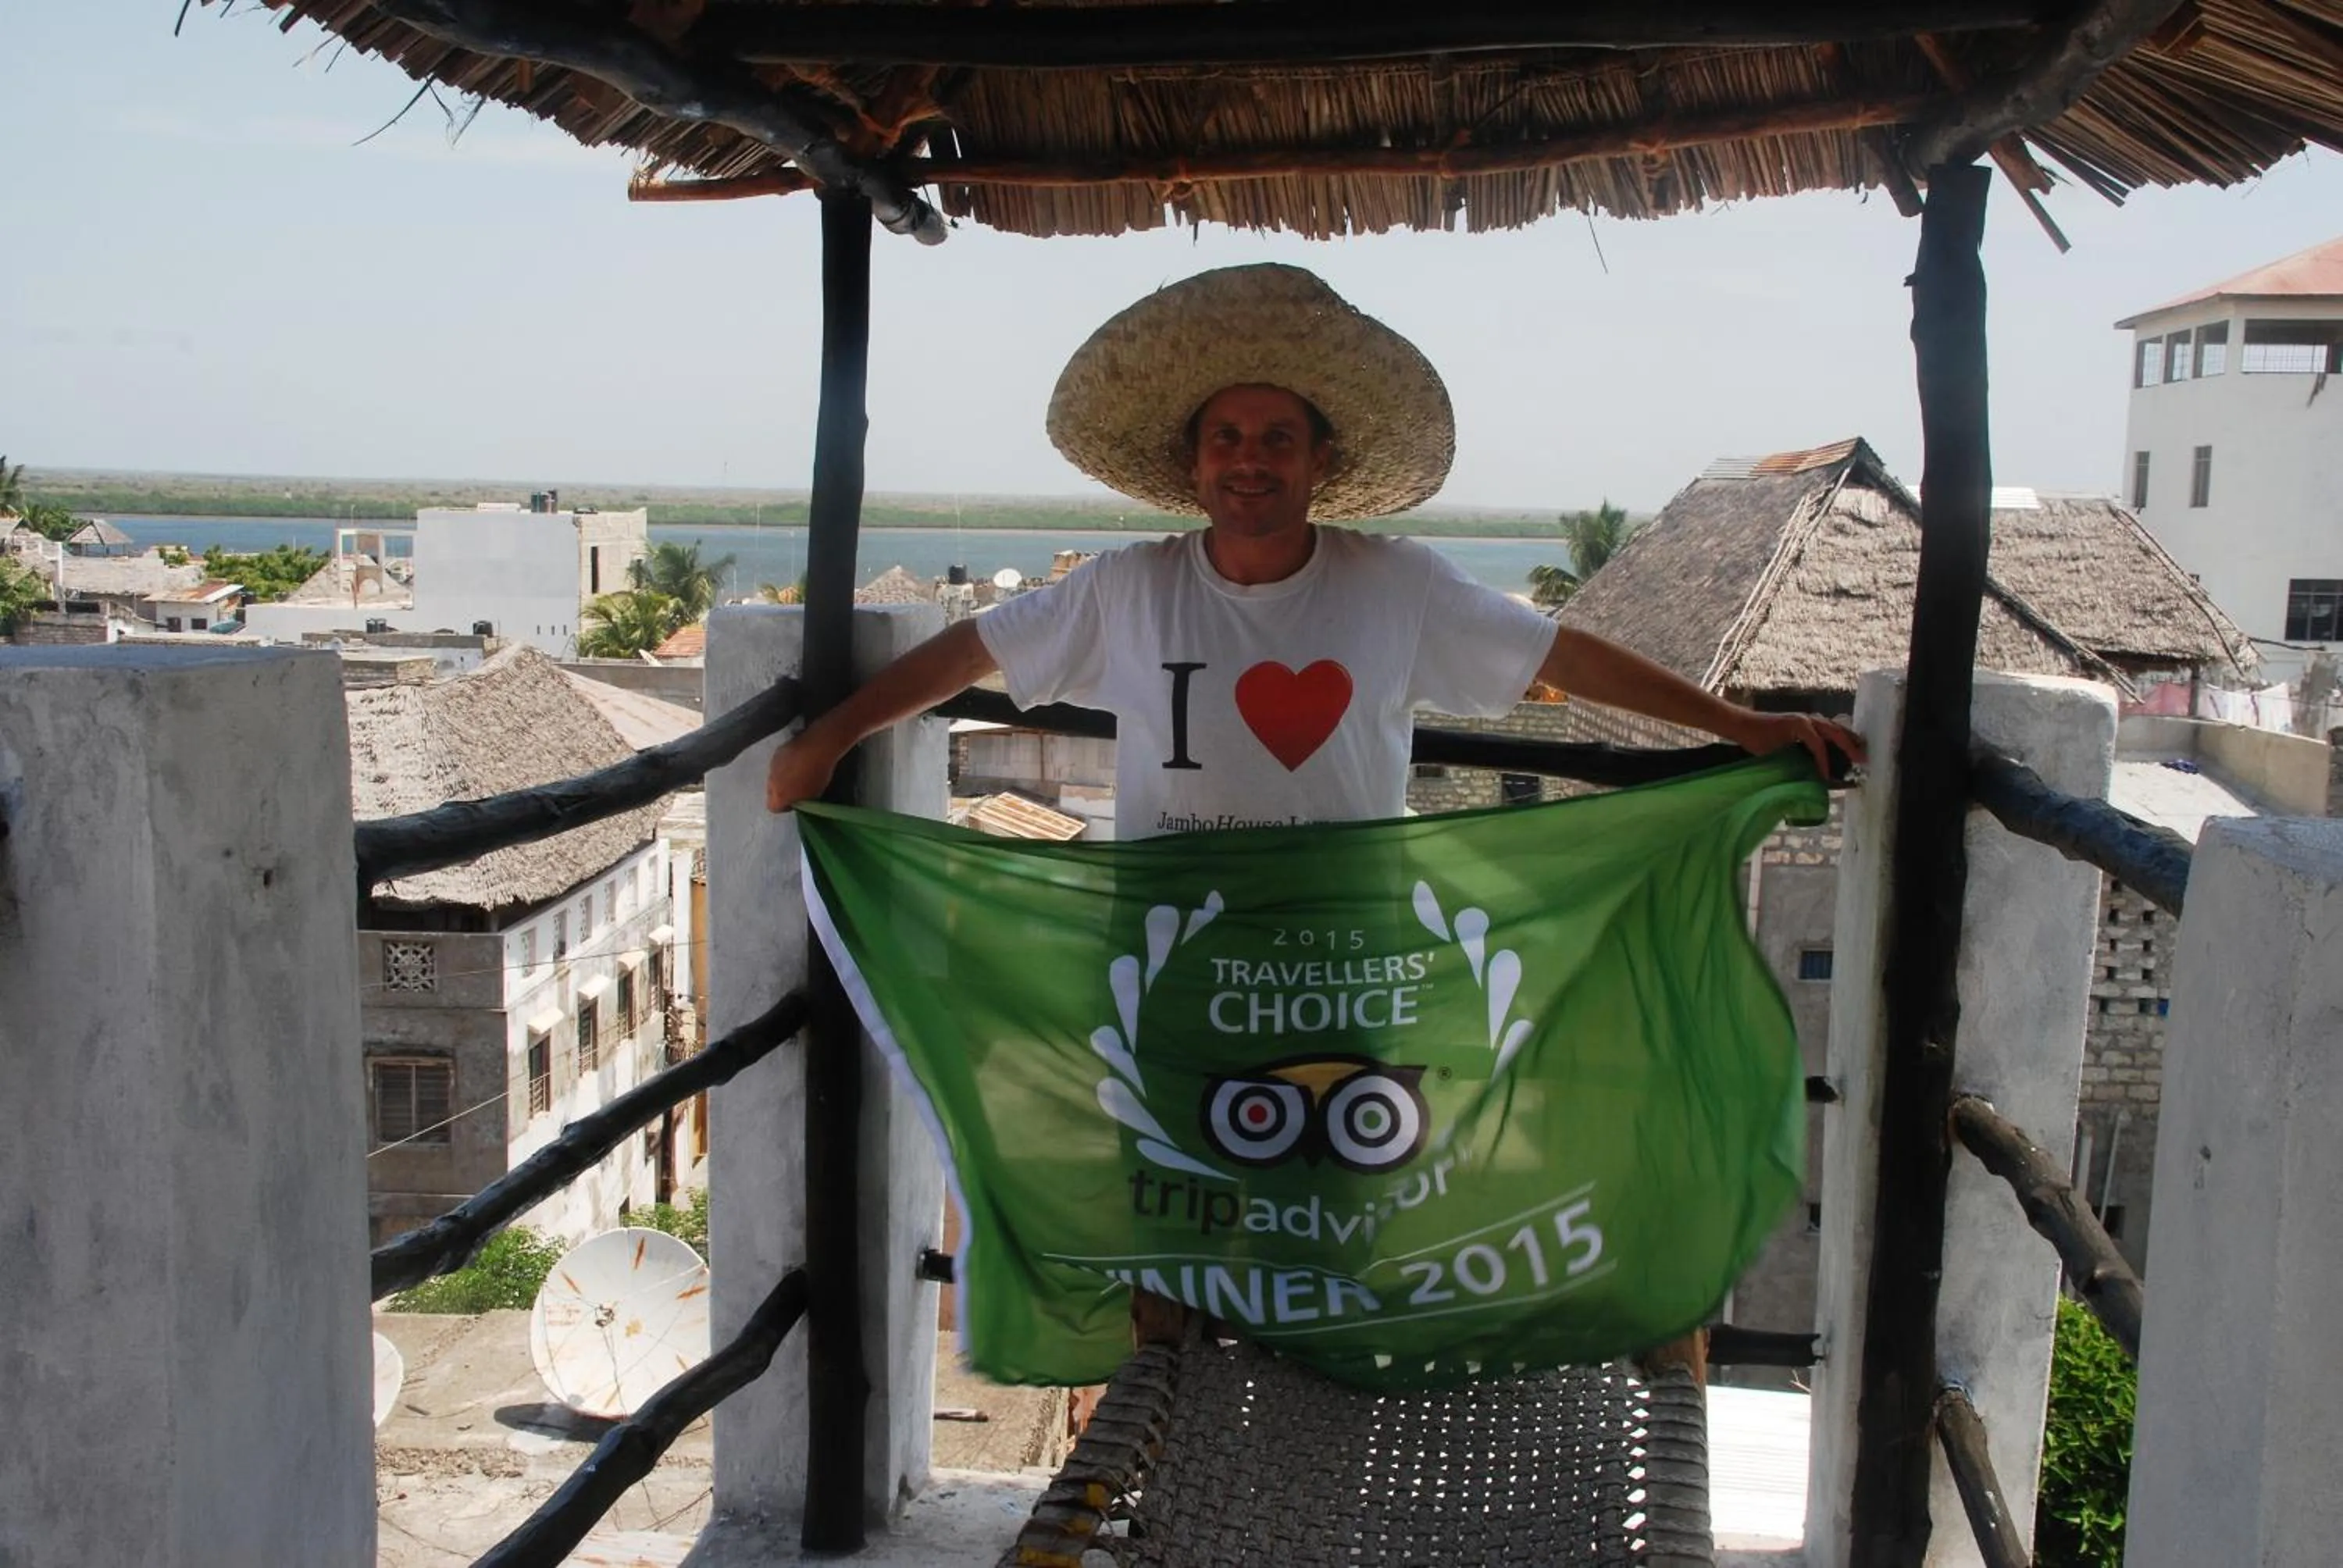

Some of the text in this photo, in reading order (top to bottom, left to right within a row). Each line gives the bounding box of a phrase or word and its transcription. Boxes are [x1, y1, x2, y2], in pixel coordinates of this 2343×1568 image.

[1162, 662, 1207, 769] I
[1211, 951, 1435, 986] TRAVELLERS'
[1273, 928, 1365, 950] 2015
[1209, 985, 1419, 1035] CHOICE
[1129, 1156, 1456, 1247] tripadvior
[1105, 1198, 1603, 1325] NNER 2015
